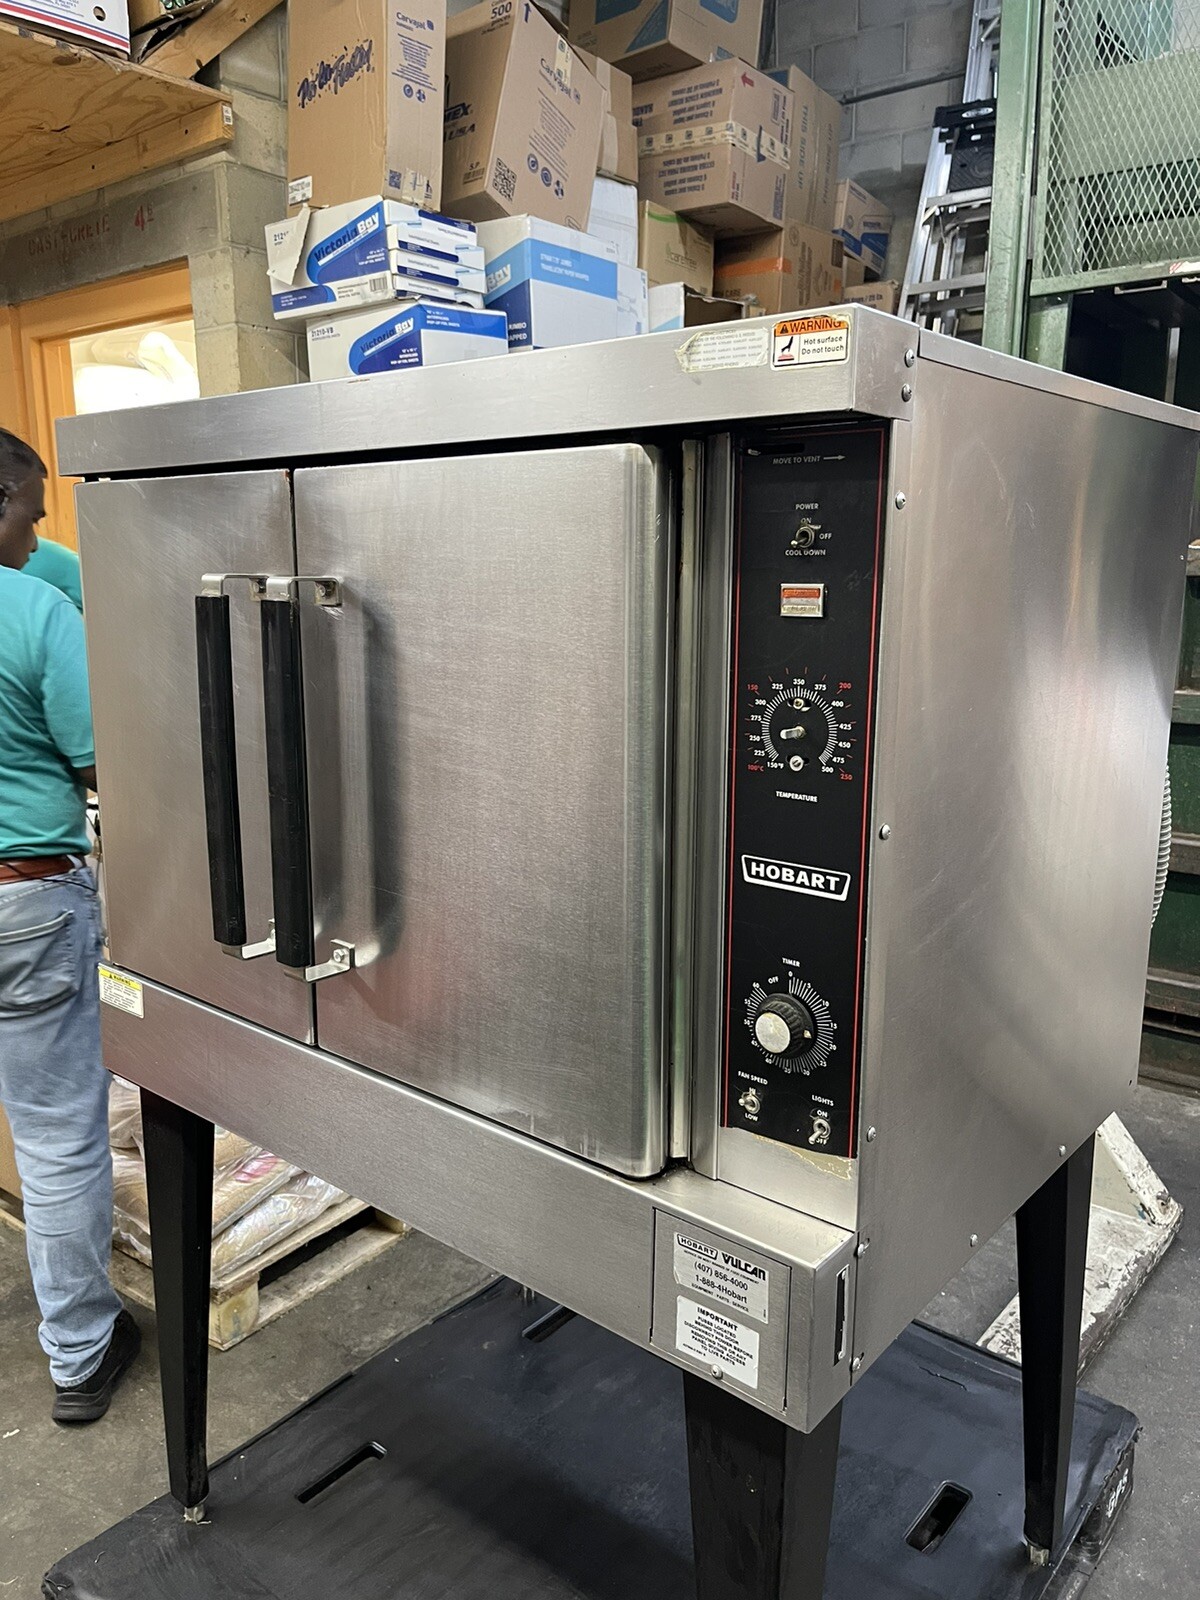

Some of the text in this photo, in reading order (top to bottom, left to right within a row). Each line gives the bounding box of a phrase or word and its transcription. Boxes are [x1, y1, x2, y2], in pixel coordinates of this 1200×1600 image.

[490, 2, 512, 19] 500
[396, 12, 426, 30] Carvajal
[789, 319, 842, 333] WARNING
[804, 335, 843, 346] Hot surface
[824, 345, 845, 353] touch
[773, 455, 821, 465] MOVE TO VENT
[776, 790, 818, 803] TEMPERATURE
[751, 861, 840, 891] HOBART
[782, 957, 800, 968] TIMER
[768, 976, 779, 984] OFF
[738, 1070, 768, 1085] FAN SPEED
[748, 1087, 756, 1095] HI
[811, 1094, 834, 1107] LIGHTS
[745, 1112, 758, 1121] LOW
[817, 1109, 828, 1118] ON
[681, 1237, 766, 1281] HOBART VULCAN
[694, 1261, 749, 1291] (407) 856-4000
[695, 1274, 748, 1304] 1-888-4Hobart
[697, 1306, 738, 1331] IMPORTANT
[713, 1328, 724, 1338] THIS
[724, 1335, 739, 1345] DOOR
[714, 1324, 737, 1339] LOCATED
[684, 1320, 753, 1360] DISCONNECT POWER BEFORE
[691, 1329, 716, 1345] REMOVING
[717, 1342, 727, 1351] THIS
[692, 1335, 708, 1346] PANEL
[708, 1348, 719, 1357] LIVE
